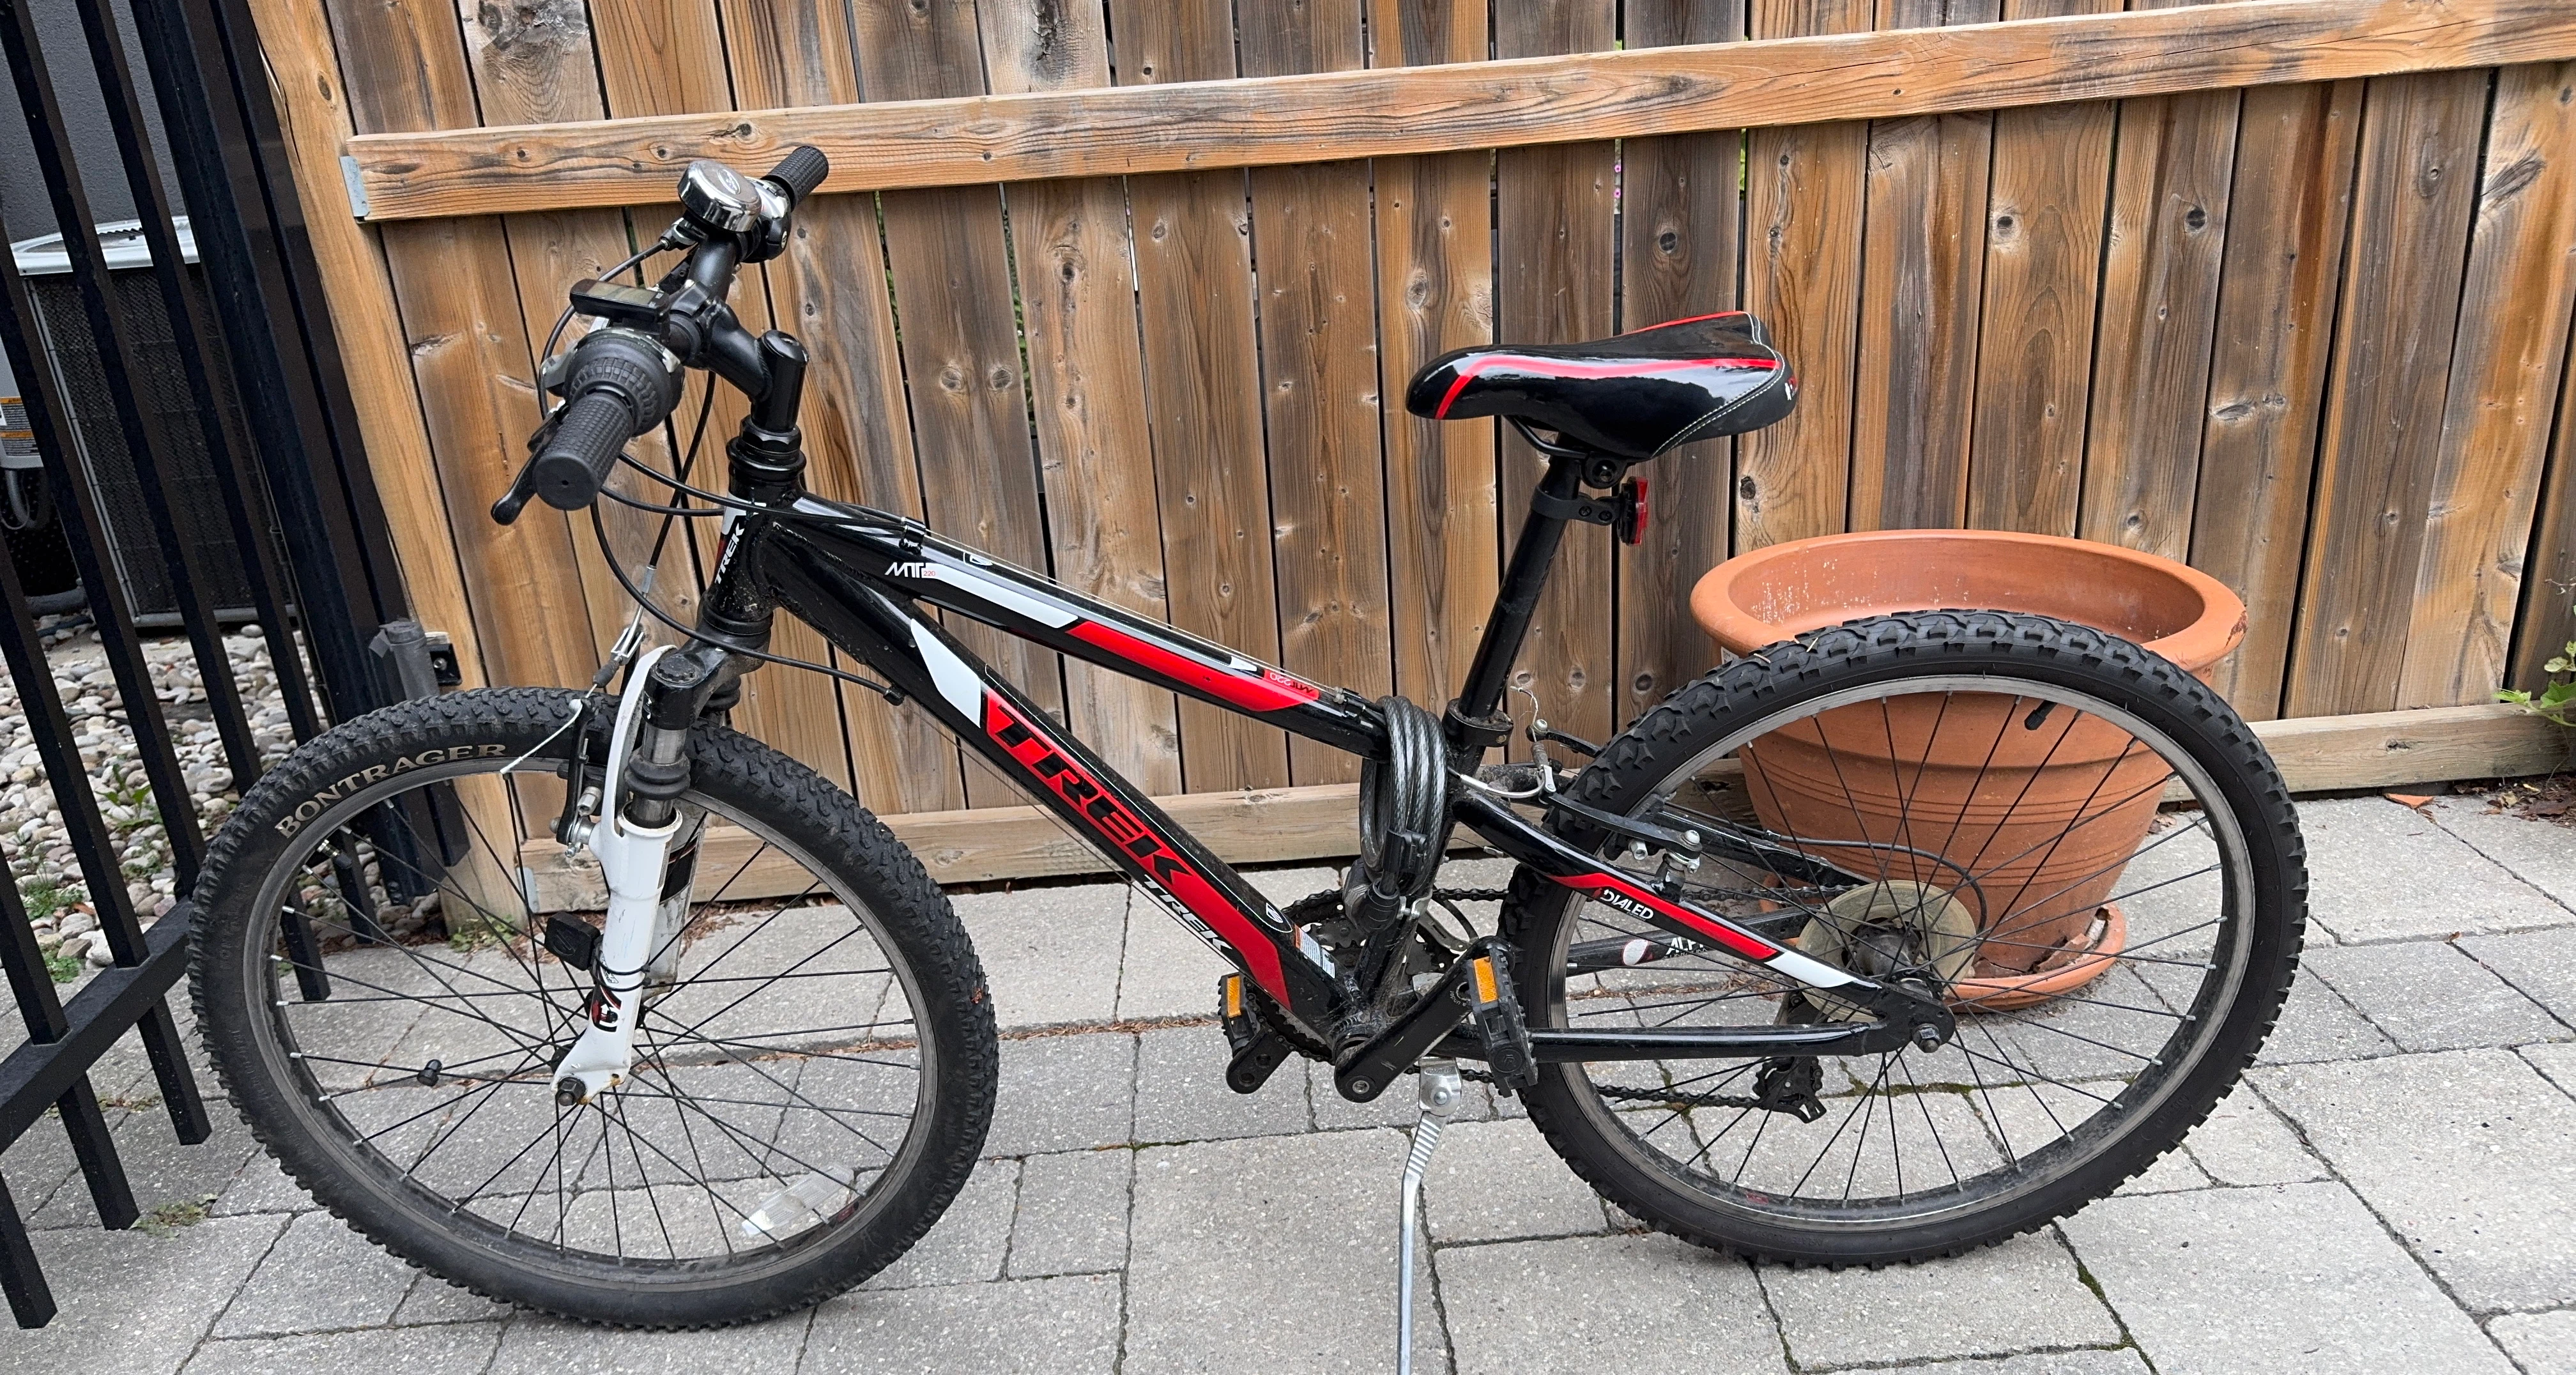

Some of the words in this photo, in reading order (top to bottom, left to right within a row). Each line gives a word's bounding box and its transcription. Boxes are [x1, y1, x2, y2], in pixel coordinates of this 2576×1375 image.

[714, 523, 745, 584] TREK
[274, 744, 507, 839] BONTRAGER
[995, 704, 1193, 885] TREK
[1144, 874, 1233, 951] TREK
[1600, 889, 1654, 920] DIALED
